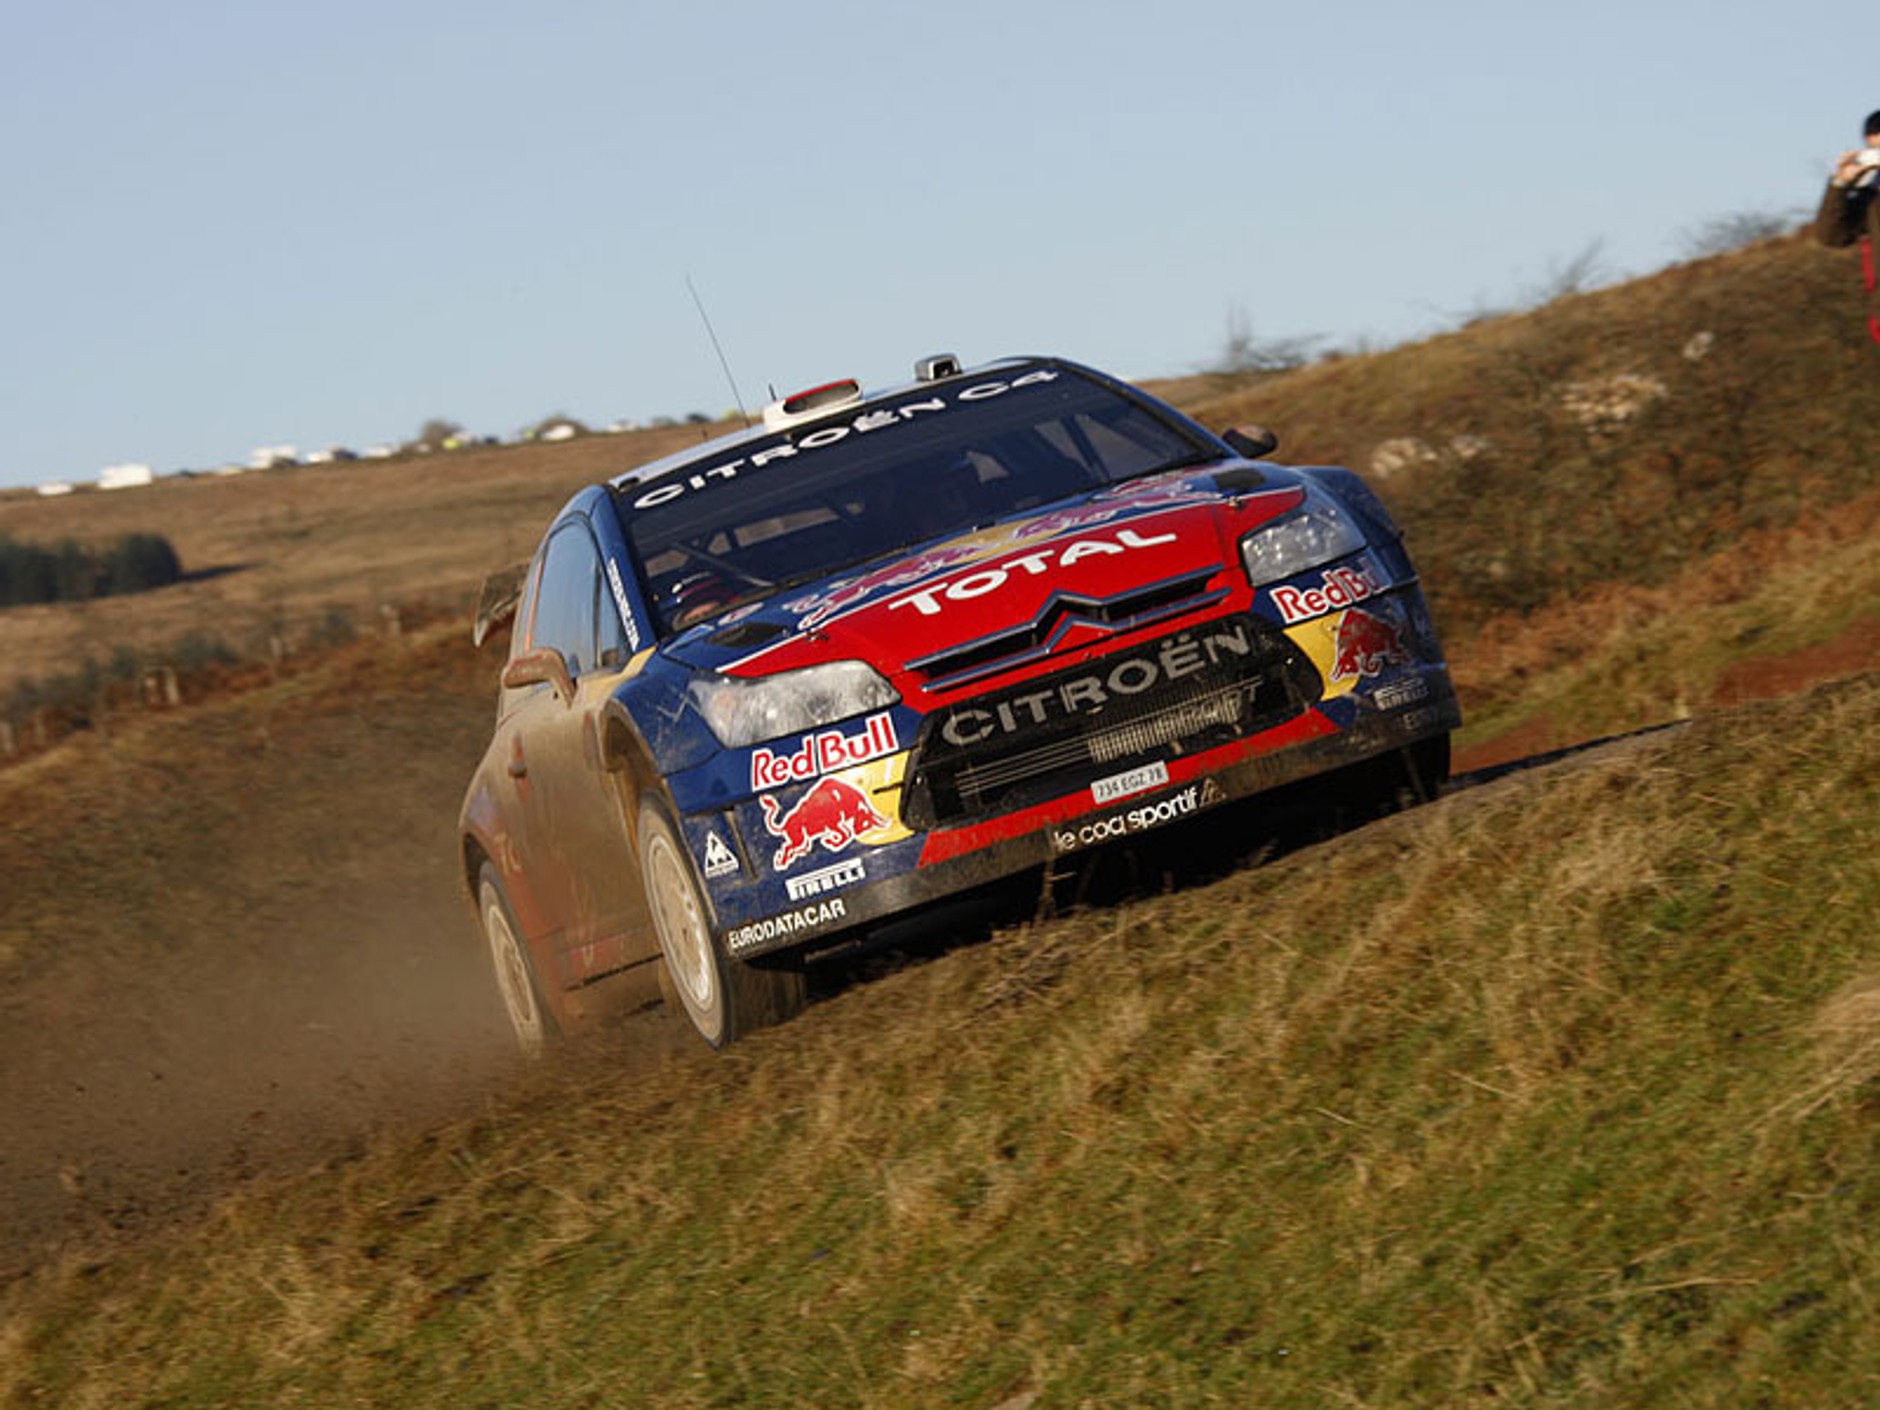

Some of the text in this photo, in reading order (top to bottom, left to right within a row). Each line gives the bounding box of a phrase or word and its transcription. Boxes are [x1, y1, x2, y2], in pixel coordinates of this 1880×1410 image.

[958, 371, 1058, 401] C4
[888, 529, 1176, 615] TOTAL
[1271, 570, 1351, 623] Red
[942, 625, 1249, 745] CITROËN
[754, 713, 898, 790] Red Bull
[1053, 787, 1197, 852] le coq sportif
[785, 858, 866, 901] PIRELLI
[728, 899, 846, 950] EURODATACAR
